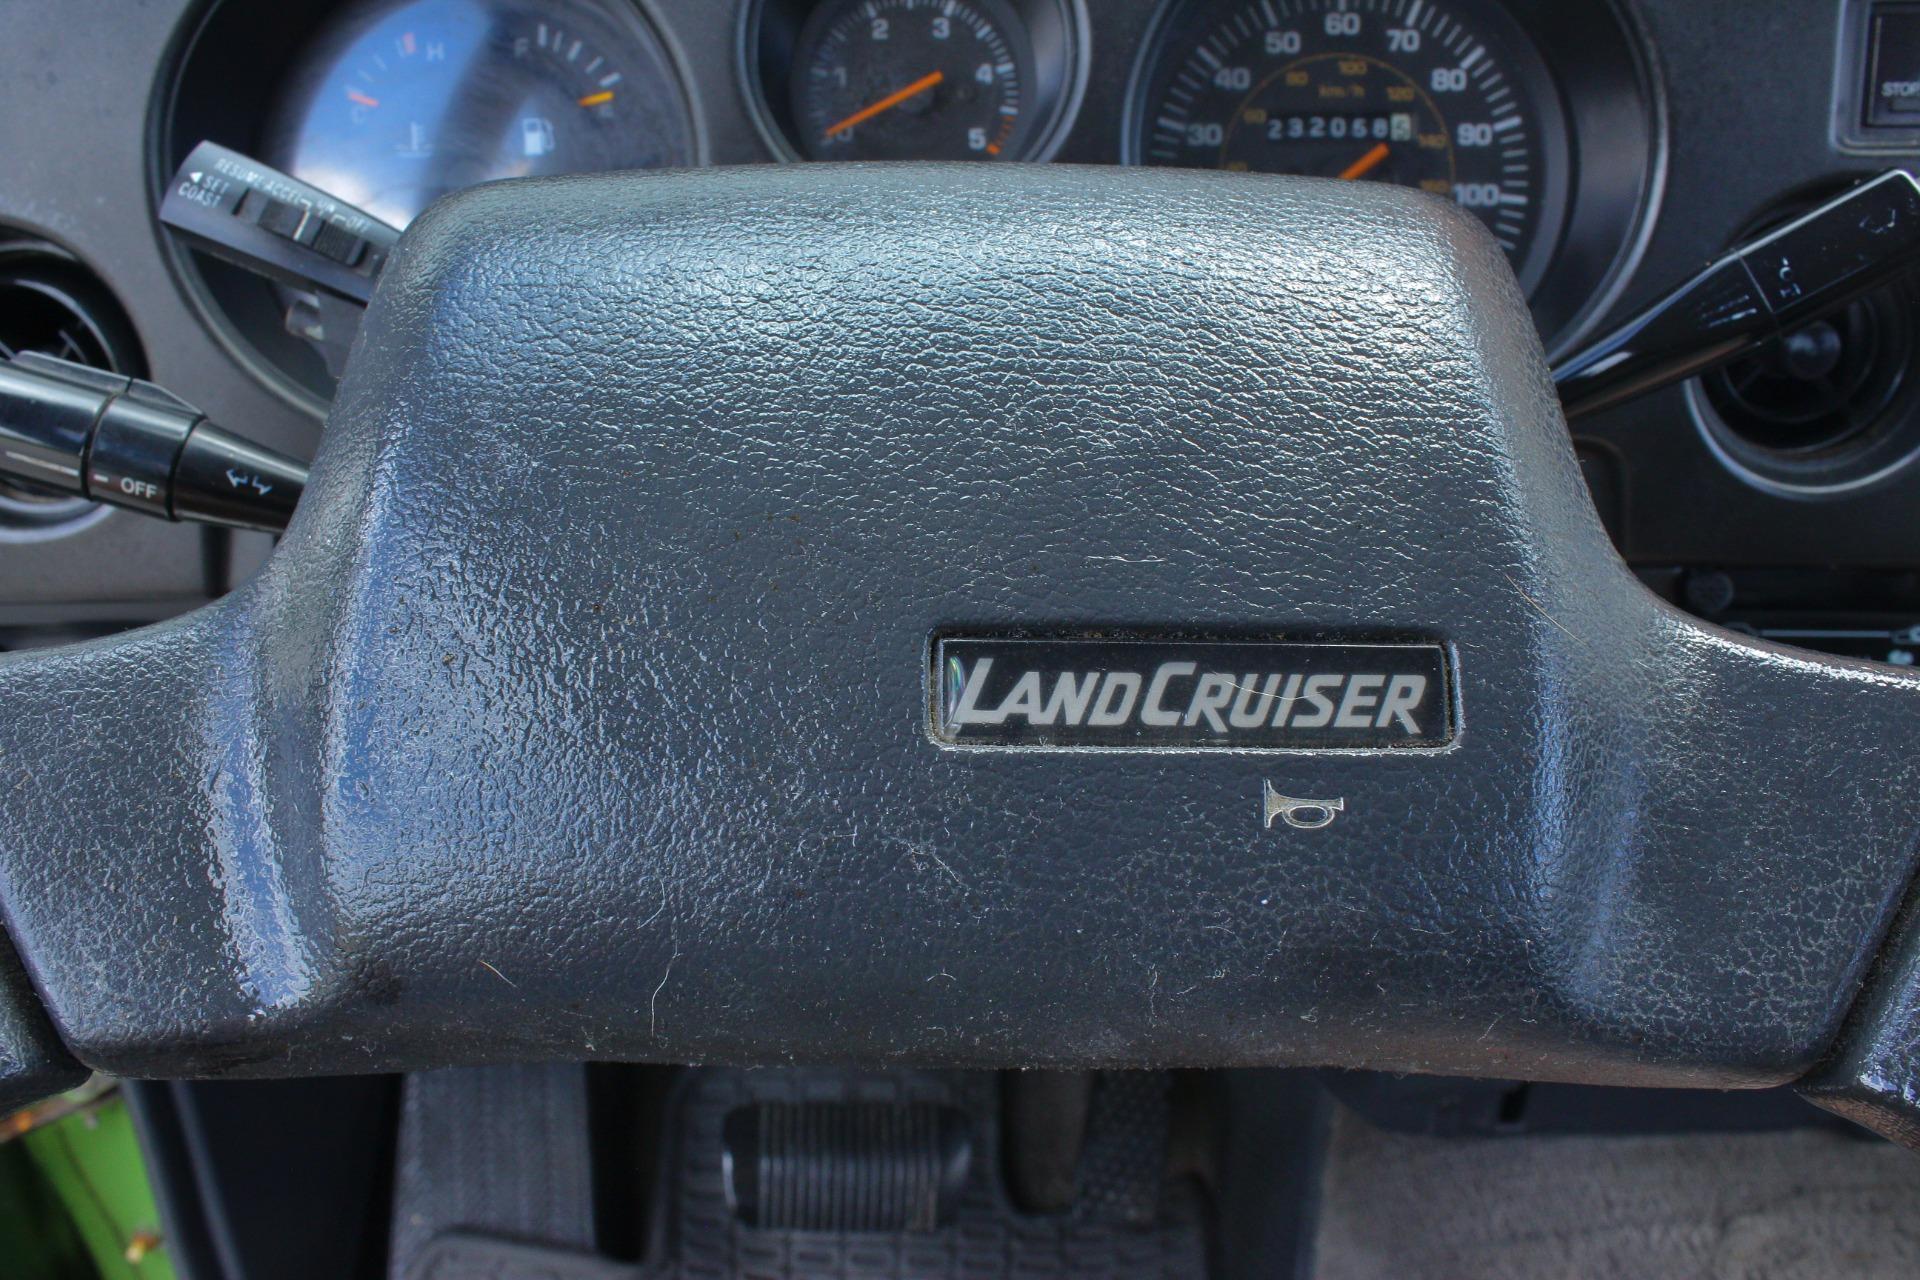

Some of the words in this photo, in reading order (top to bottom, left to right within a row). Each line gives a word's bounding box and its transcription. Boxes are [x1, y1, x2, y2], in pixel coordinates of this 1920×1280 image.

[871, 17, 889, 40] 2
[932, 16, 950, 39] 3
[1325, 13, 1360, 35] 60
[426, 41, 444, 61] H
[1264, 31, 1301, 54] 50
[1386, 29, 1420, 52] 70
[832, 66, 847, 87] 1
[975, 63, 992, 85] 4
[1213, 67, 1251, 91] 40
[1431, 67, 1467, 91] 80
[967, 127, 986, 149] 5
[1187, 123, 1223, 146] 30
[177, 181, 223, 209] COAST
[202, 175, 231, 193] SET
[1453, 183, 1500, 207] 100
[120, 476, 157, 499] OFF
